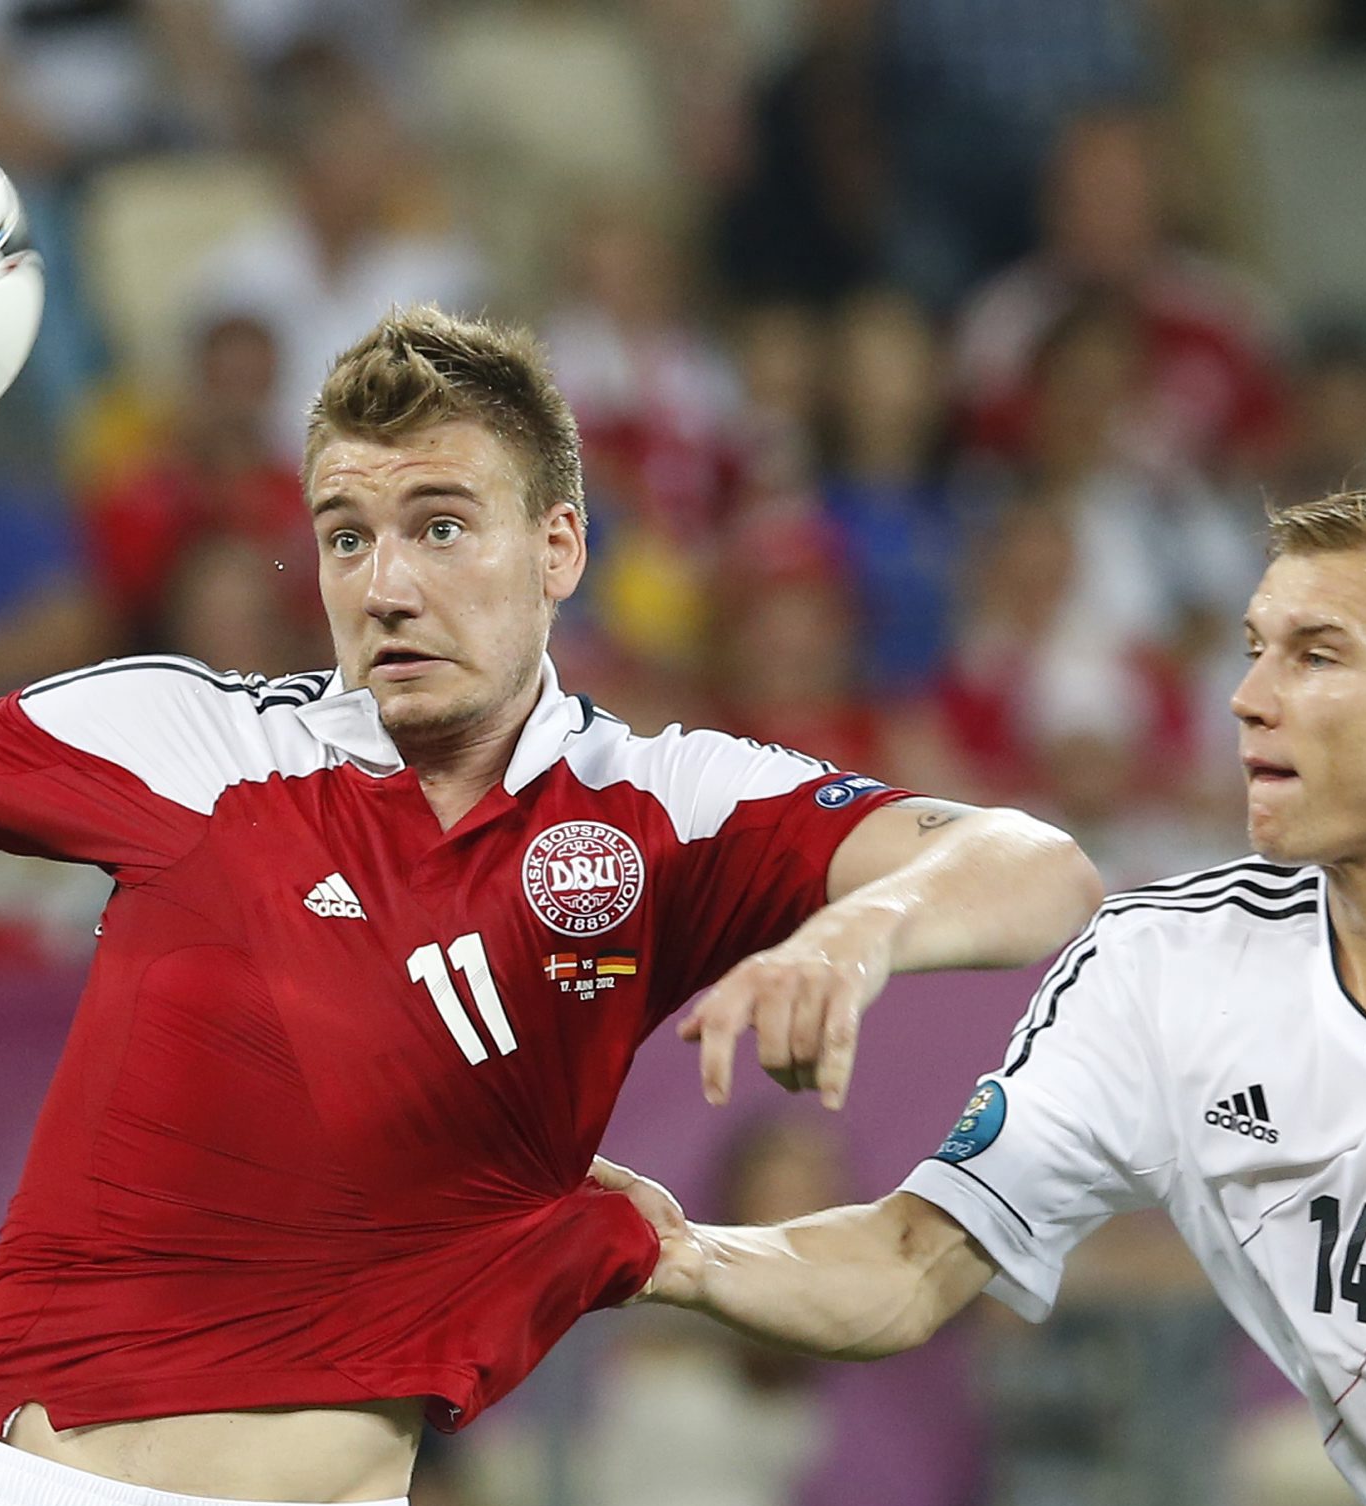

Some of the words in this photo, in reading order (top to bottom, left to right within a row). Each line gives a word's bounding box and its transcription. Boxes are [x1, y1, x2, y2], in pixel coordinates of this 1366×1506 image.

[528, 855, 561, 922] DANSK
[547, 855, 620, 892] DBU
[563, 912, 611, 931] 1889
[405, 931, 519, 1066] 11
[1204, 1106, 1280, 1145] adidas
